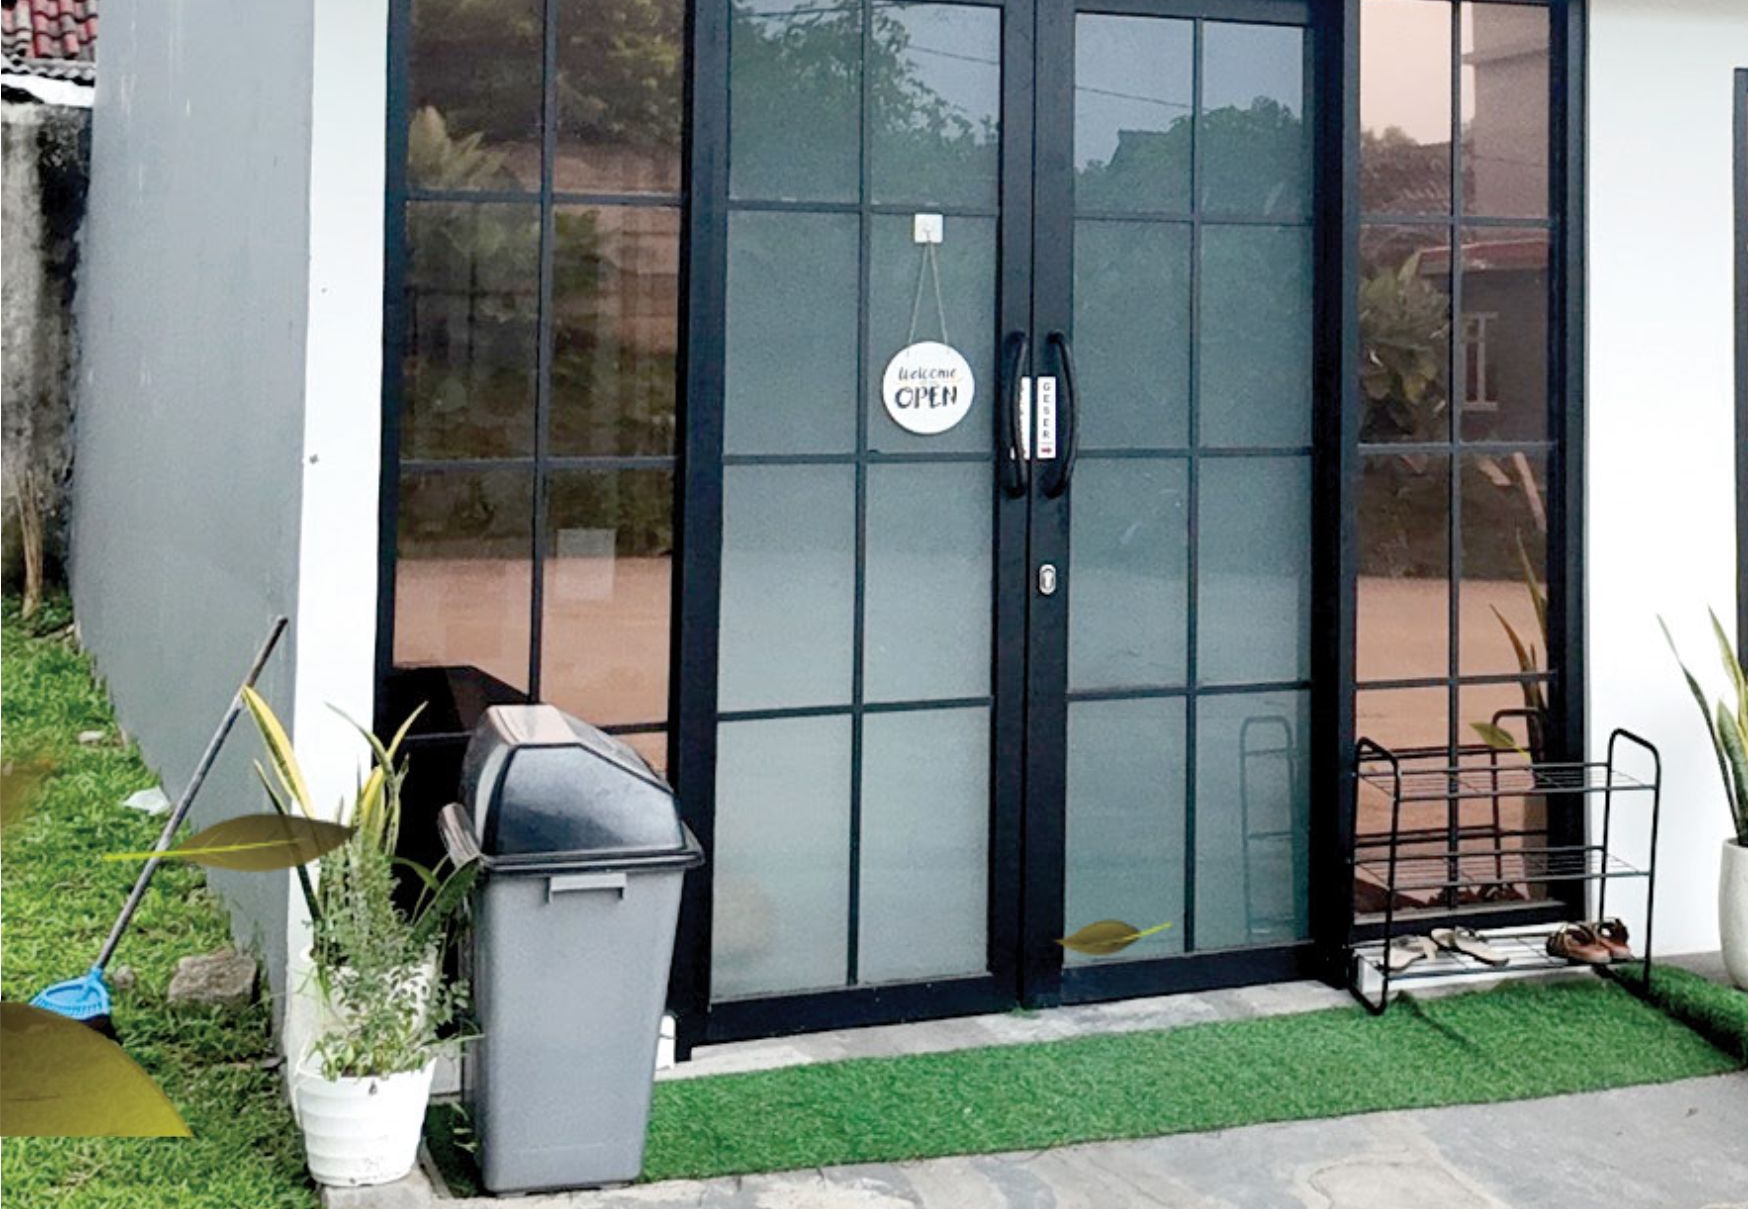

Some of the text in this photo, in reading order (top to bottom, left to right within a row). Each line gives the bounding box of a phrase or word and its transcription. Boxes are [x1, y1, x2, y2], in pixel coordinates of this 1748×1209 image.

[898, 366, 956, 381] Welcome
[895, 385, 958, 409] OPEN
[1042, 382, 1052, 439] GESER
